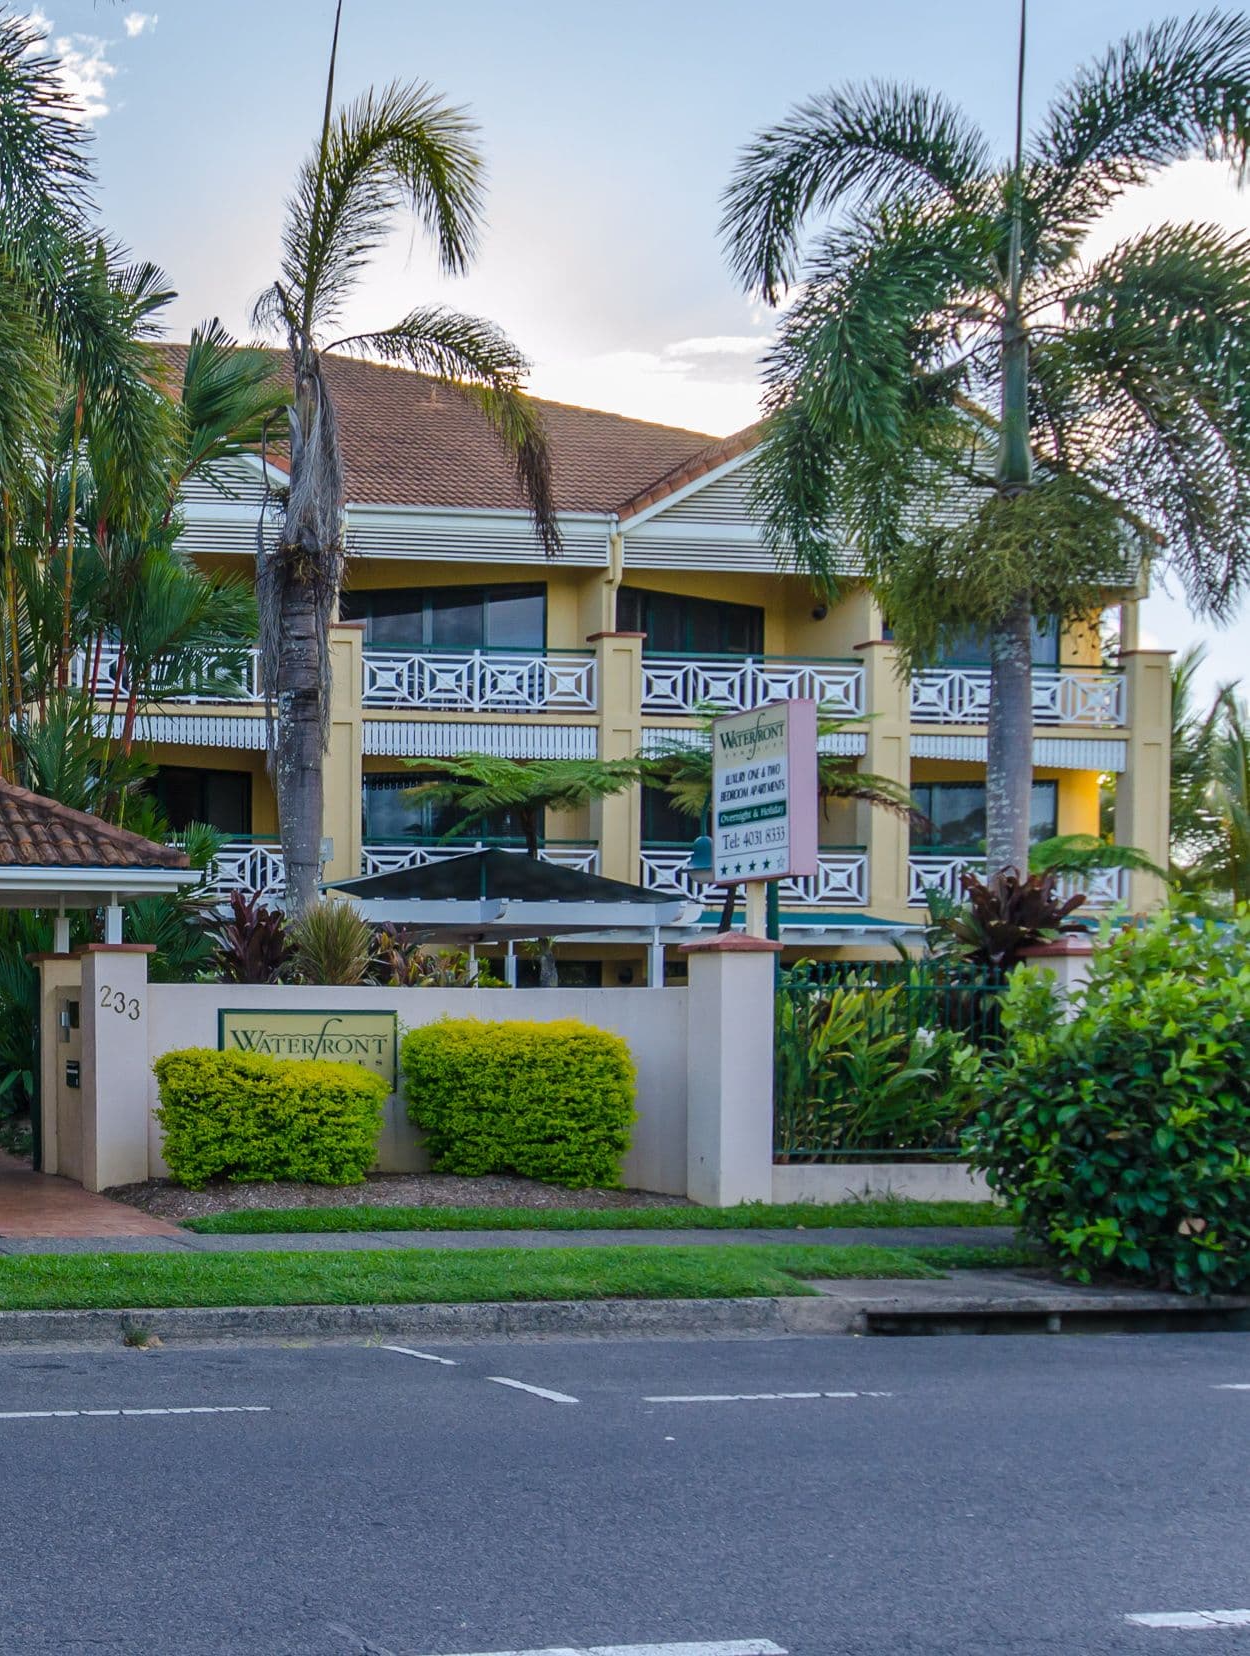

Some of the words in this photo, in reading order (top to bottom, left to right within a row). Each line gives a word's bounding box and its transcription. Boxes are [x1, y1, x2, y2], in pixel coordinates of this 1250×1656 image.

[725, 771, 746, 786] LUXURY
[748, 767, 760, 781] ONE
[767, 763, 781, 777] TWO
[720, 786, 749, 803] BEDROOM
[750, 778, 786, 797] APARTMENTS
[720, 809, 752, 825] Overnight
[753, 807, 759, 819] &
[760, 804, 785, 818] Holiday
[722, 832, 740, 850] Tel:
[743, 830, 763, 848] 4031
[765, 826, 785, 844] 8333
[100, 985, 140, 1021] 233
